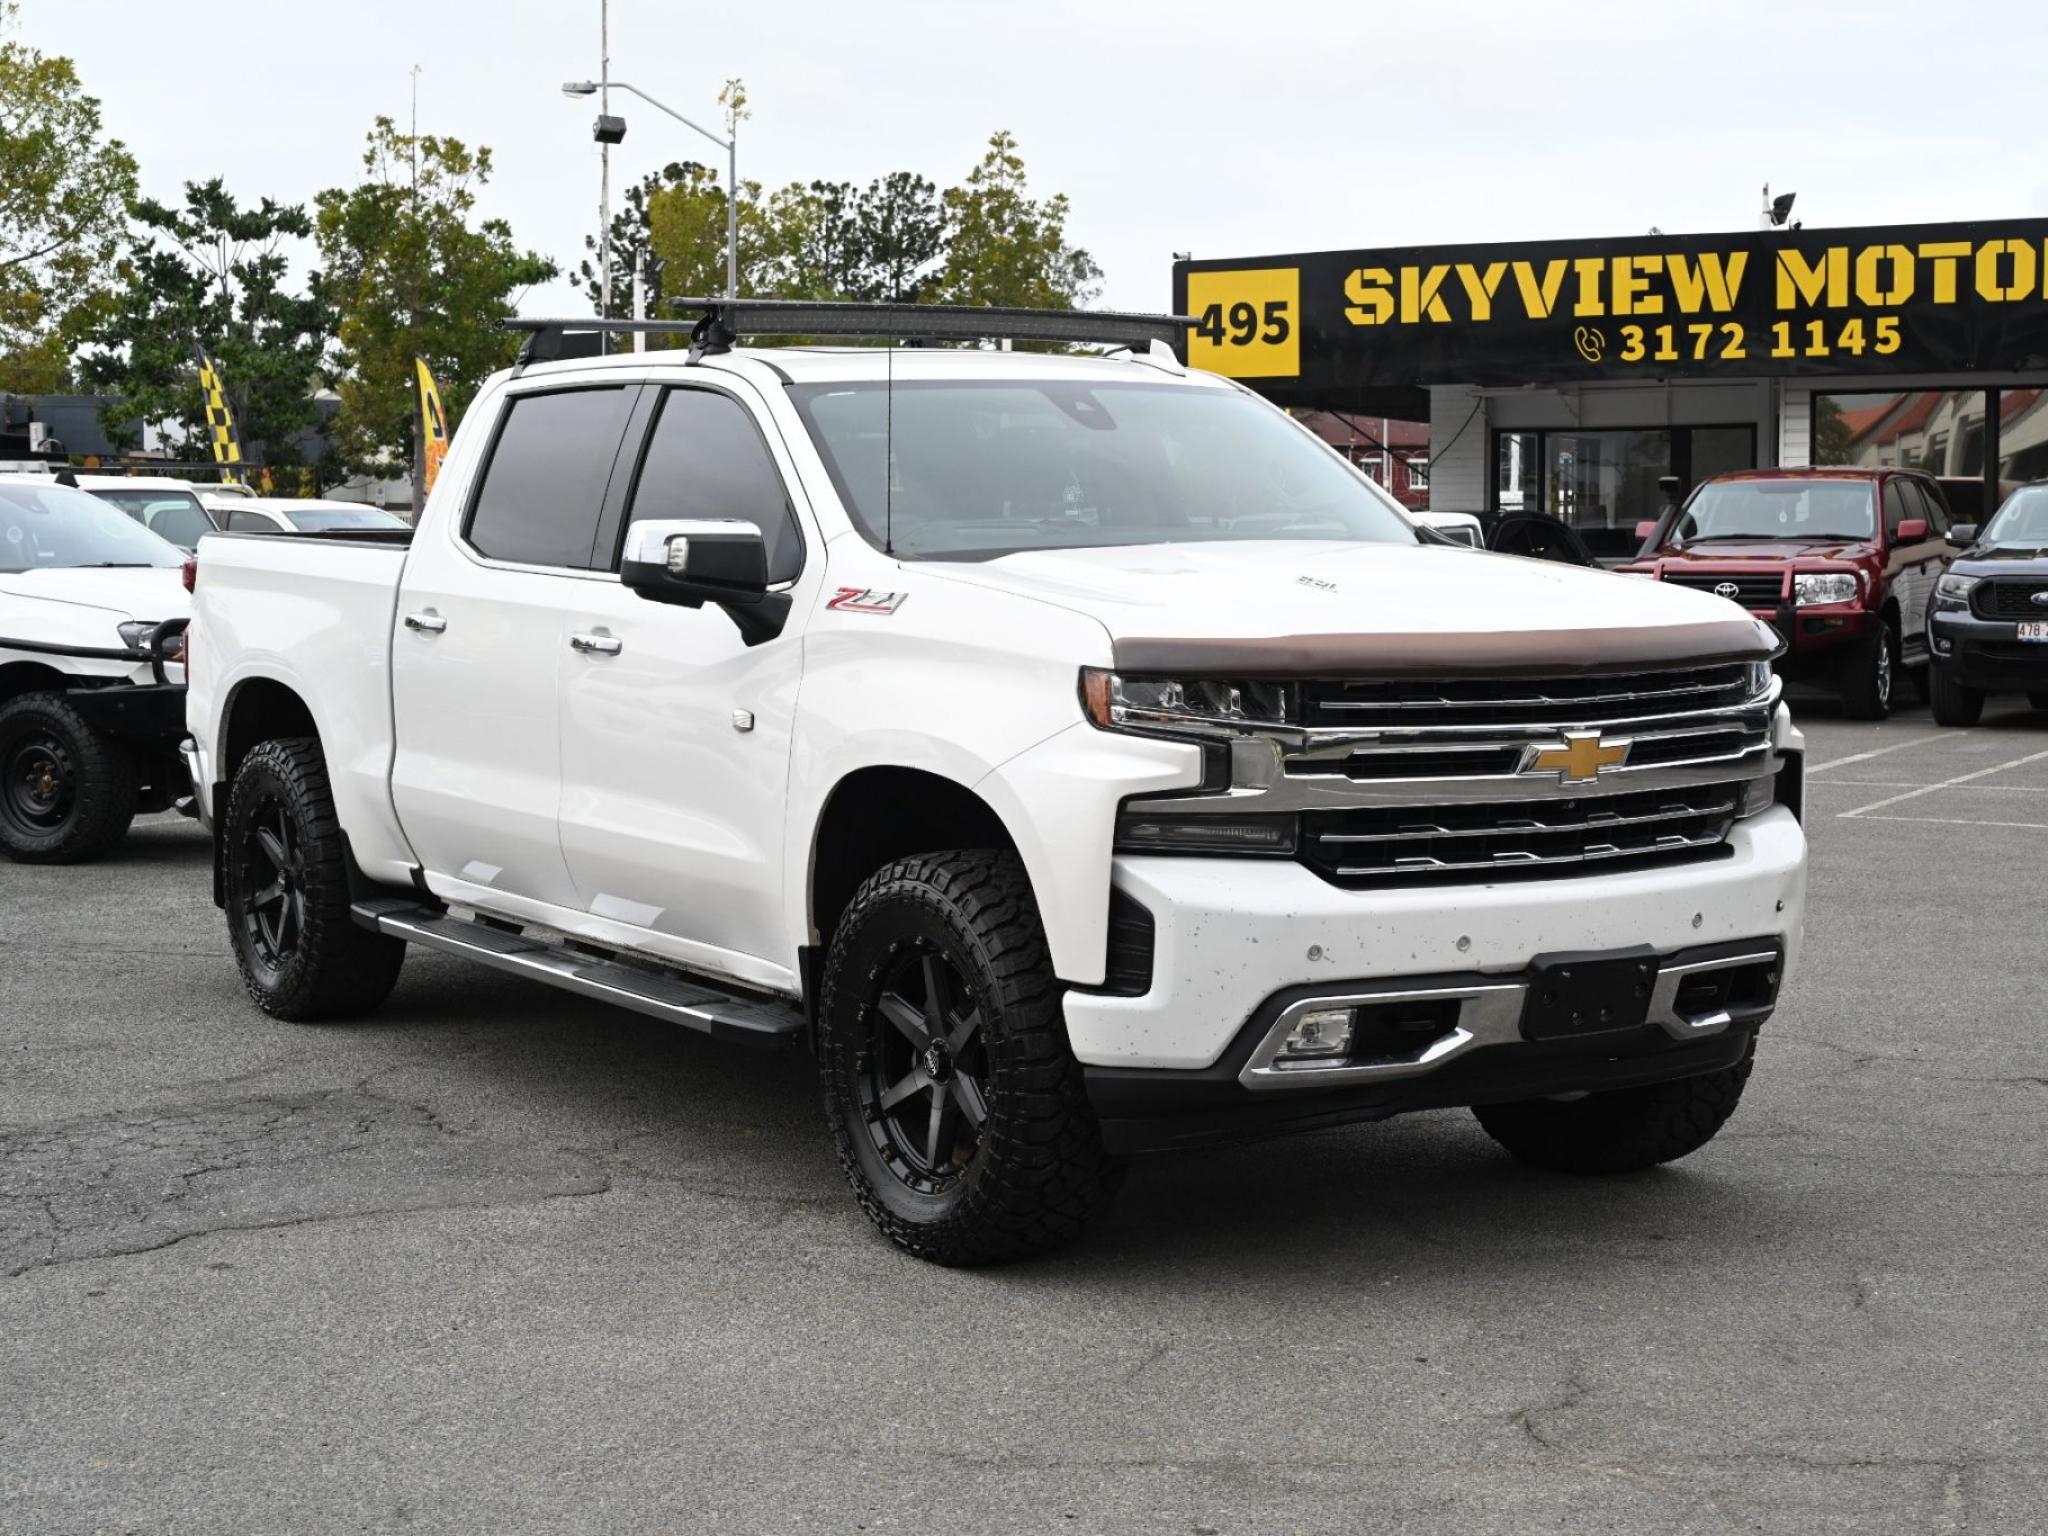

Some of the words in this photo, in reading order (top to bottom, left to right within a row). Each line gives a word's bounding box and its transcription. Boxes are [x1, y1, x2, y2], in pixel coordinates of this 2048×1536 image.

[1344, 251, 1749, 325] SKYVIEW
[1776, 238, 2048, 310] MOTO
[1196, 301, 1290, 347] 495
[1620, 322, 1747, 362] 3172
[1771, 316, 1901, 358] 1145
